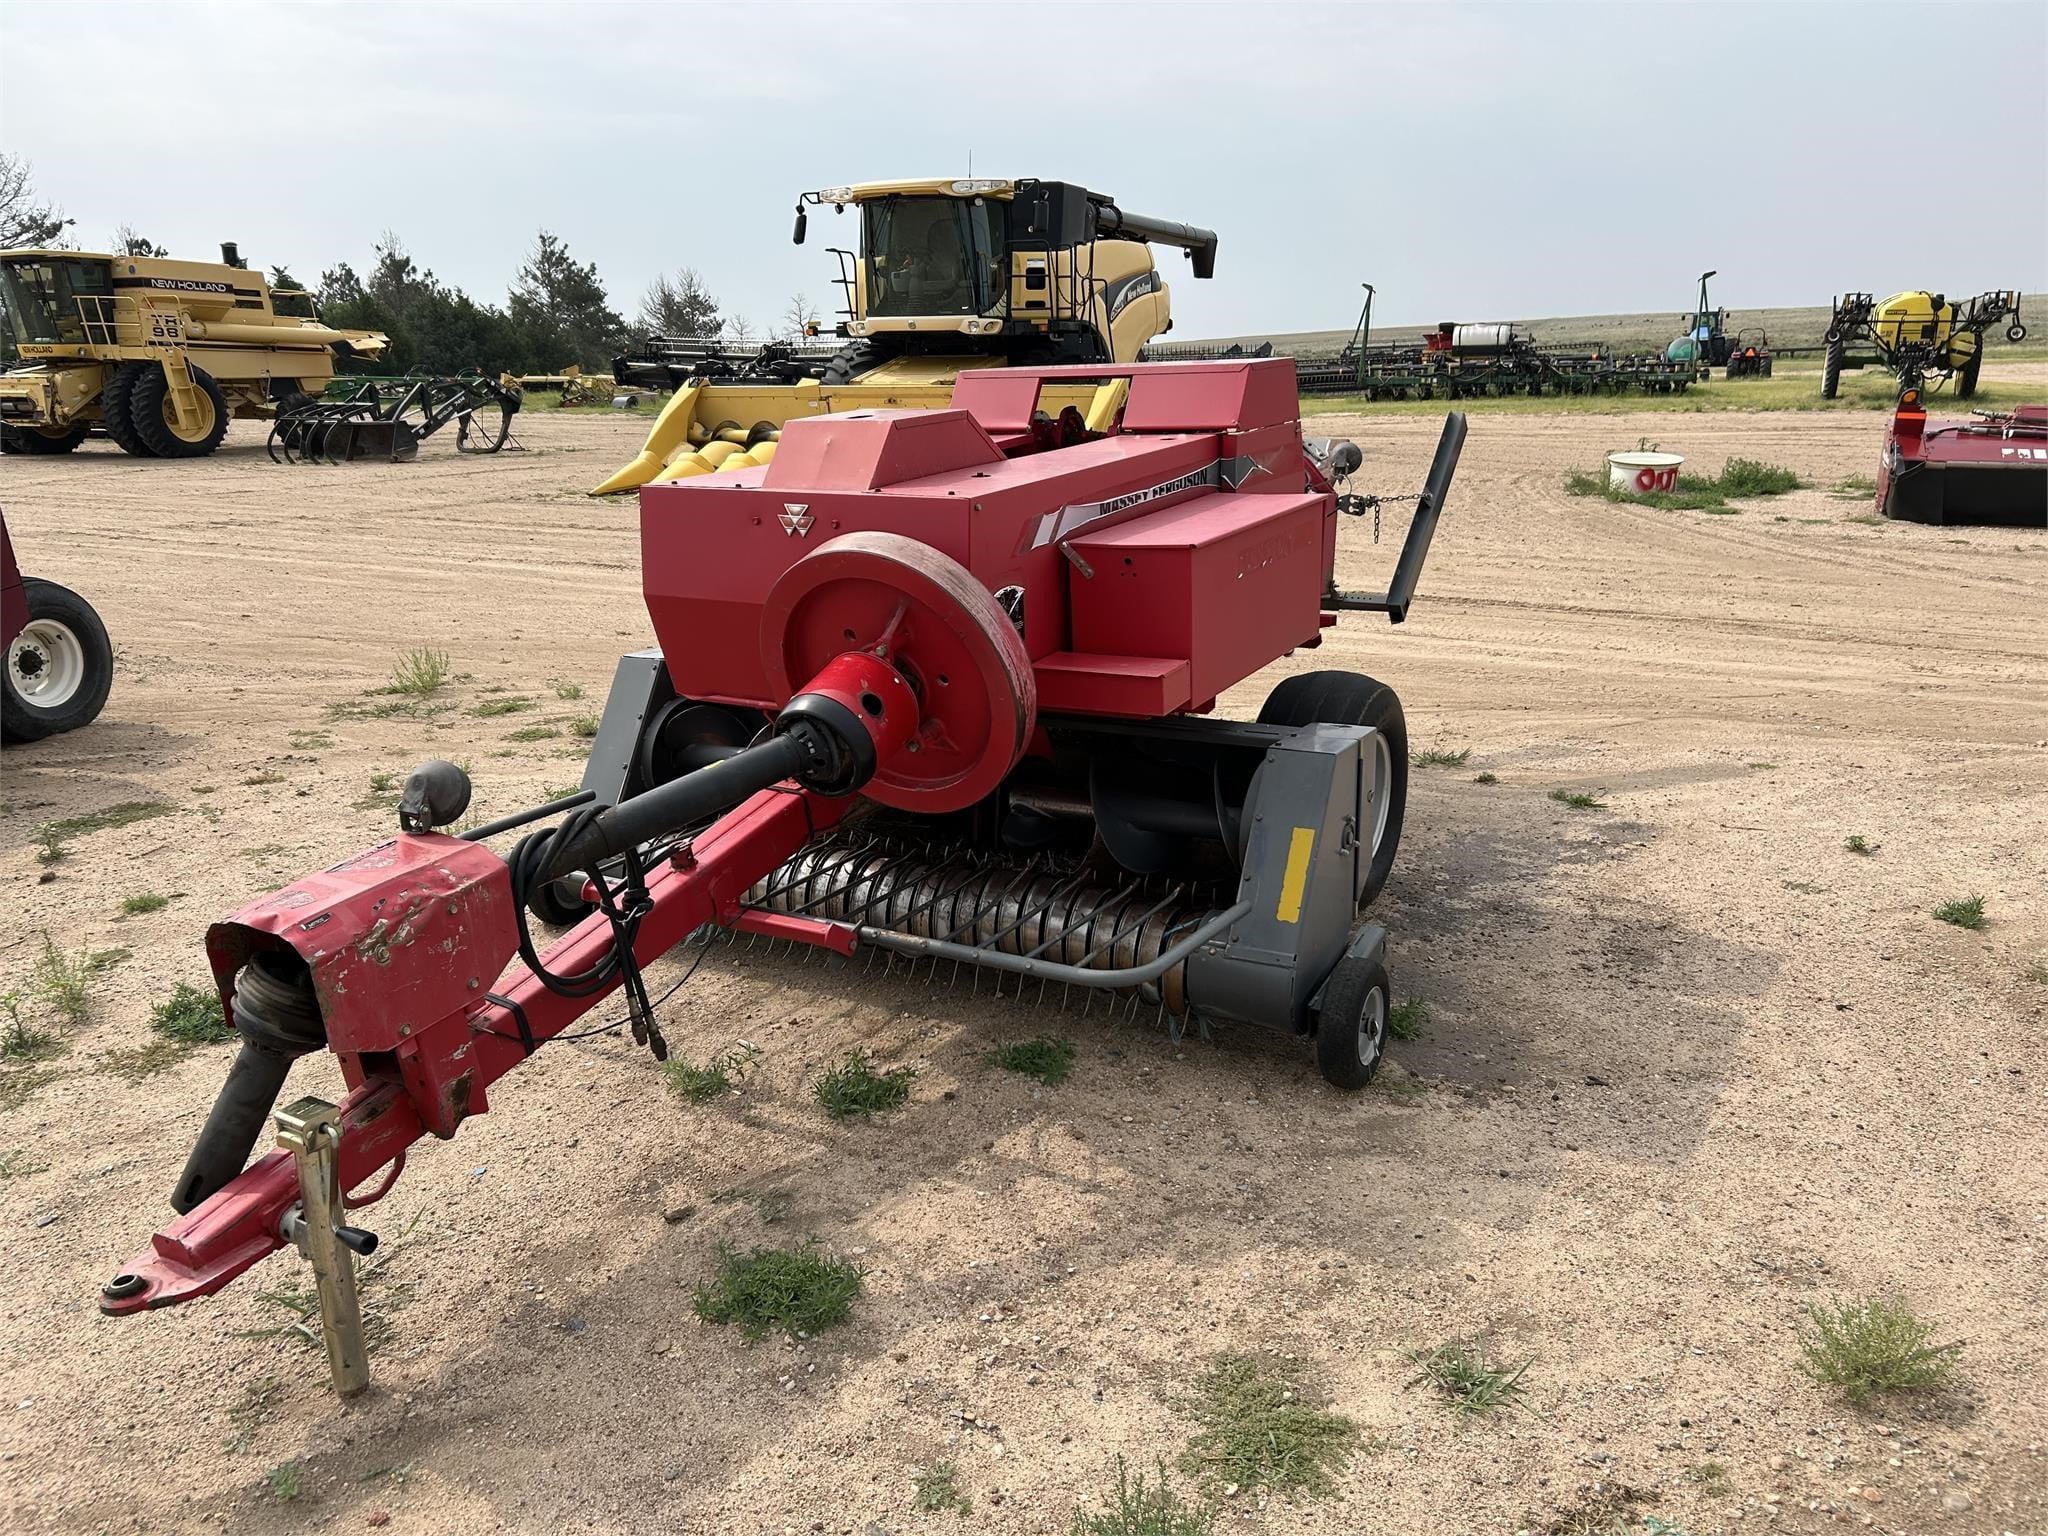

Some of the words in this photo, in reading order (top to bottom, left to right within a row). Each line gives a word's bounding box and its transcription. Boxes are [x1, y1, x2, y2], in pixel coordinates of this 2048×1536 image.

[151, 278, 176, 289] NEW
[177, 282, 227, 293] HOLLAND
[1126, 290, 1138, 302] New
[1136, 280, 1152, 297] Holland
[153, 326, 179, 338] 98
[1099, 490, 1151, 516] MASSEY
[1152, 467, 1208, 499] FERGUSON
